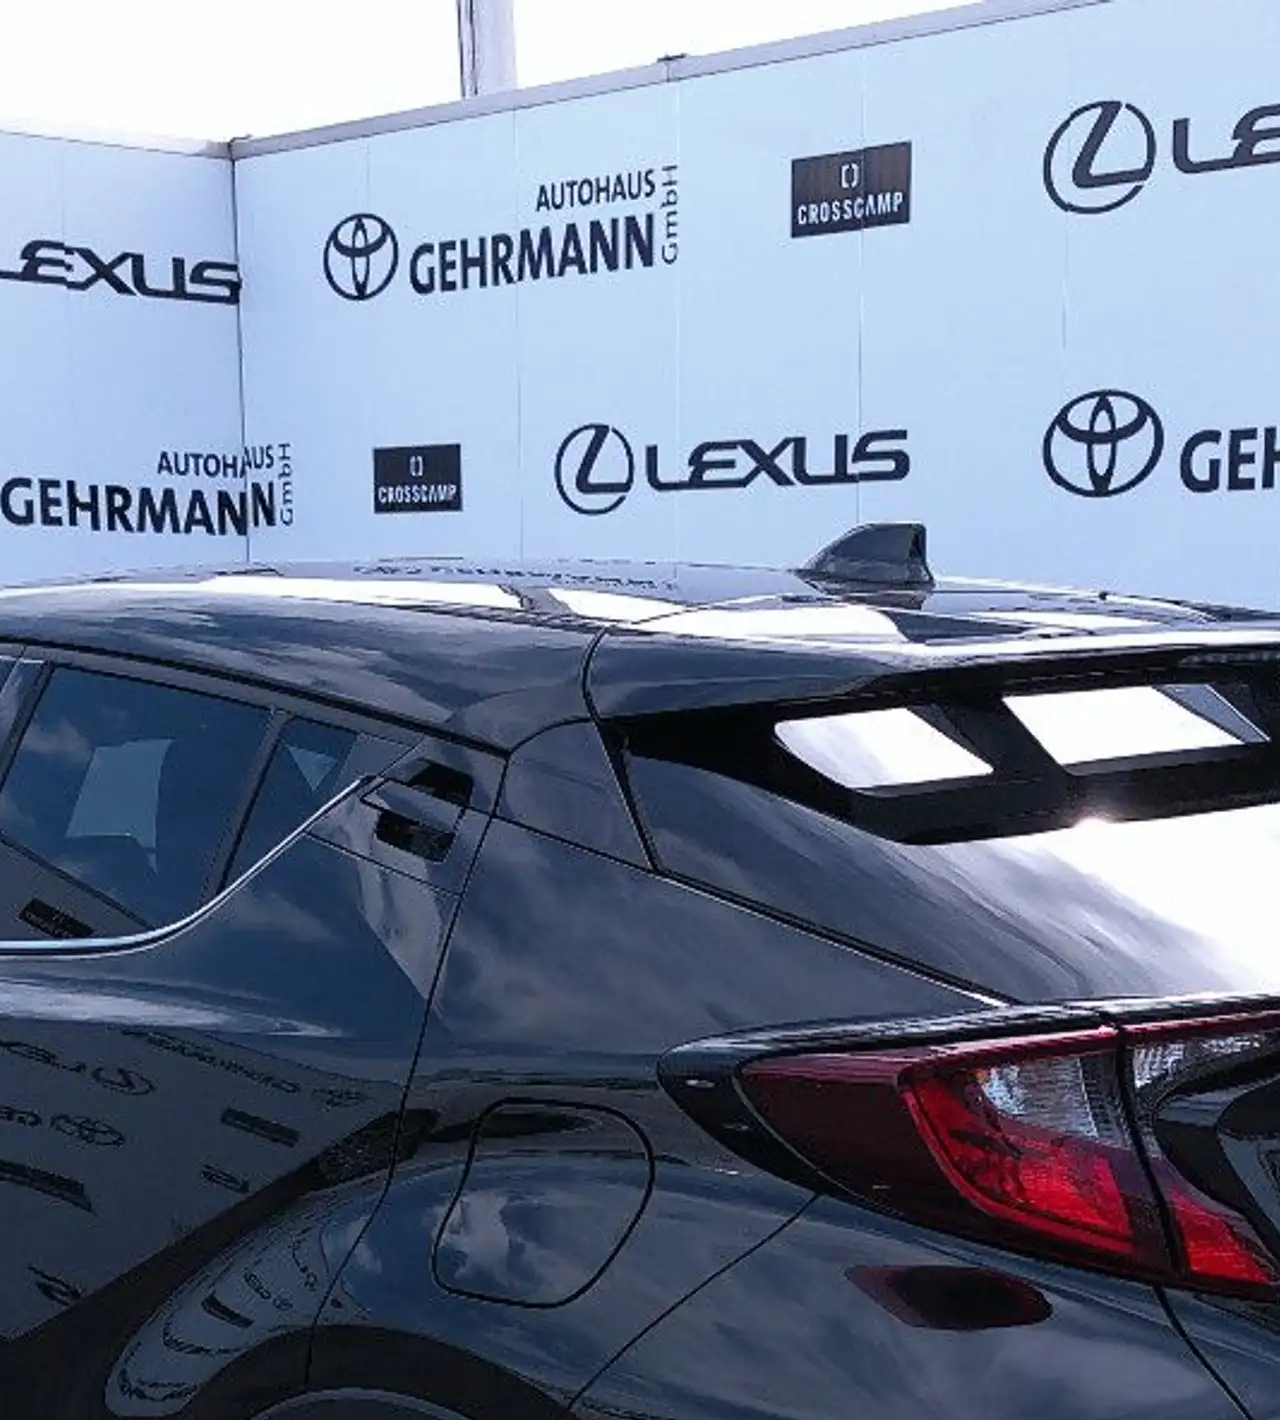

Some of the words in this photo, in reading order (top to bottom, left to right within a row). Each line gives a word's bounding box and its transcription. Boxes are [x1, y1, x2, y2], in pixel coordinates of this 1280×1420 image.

[536, 168, 657, 213] AUTOHAUS
[660, 164, 680, 265] GmbH
[796, 192, 905, 226] CROSSCAMP
[409, 213, 655, 296] GEHRMANN
[156, 445, 275, 479] AUTOHAUS
[278, 443, 293, 527] GmbH
[646, 429, 911, 492] LEXUS
[0, 476, 277, 537] GEHRMANN
[378, 484, 457, 504] CROSSCAMP
